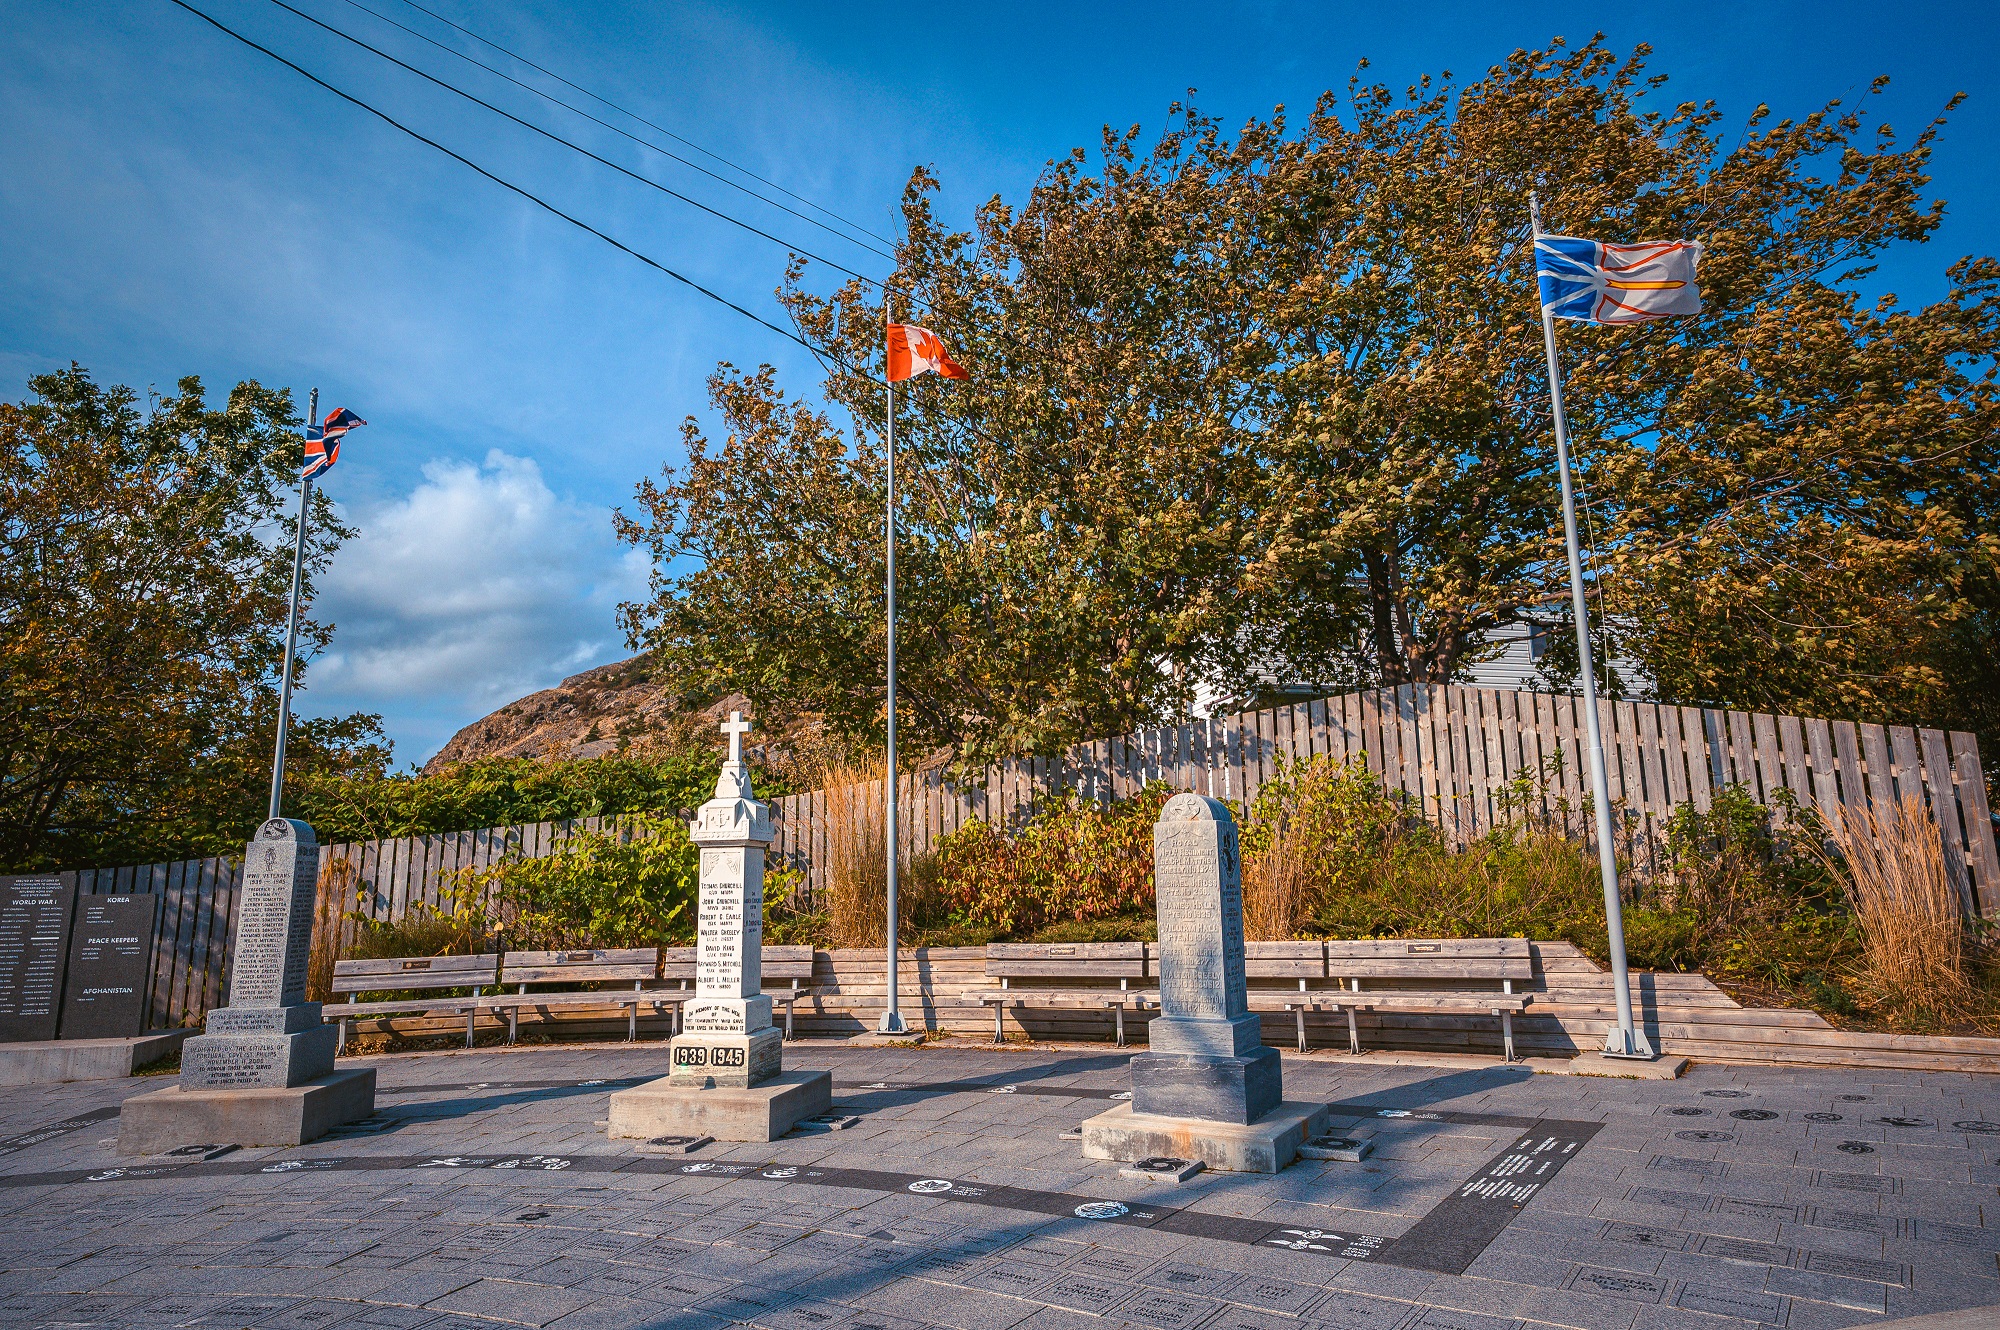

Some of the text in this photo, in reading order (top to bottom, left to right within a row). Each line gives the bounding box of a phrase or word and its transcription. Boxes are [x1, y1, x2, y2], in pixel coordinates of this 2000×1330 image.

[1164, 901, 1190, 910] JAMES
[1164, 923, 1196, 932] WILLIAM
[1161, 947, 1182, 956] PETER
[1164, 970, 1221, 980] WALTER GREELY
[676, 1048, 743, 1065] 1939 1945
[1589, 1273, 1654, 1287] SECOND
